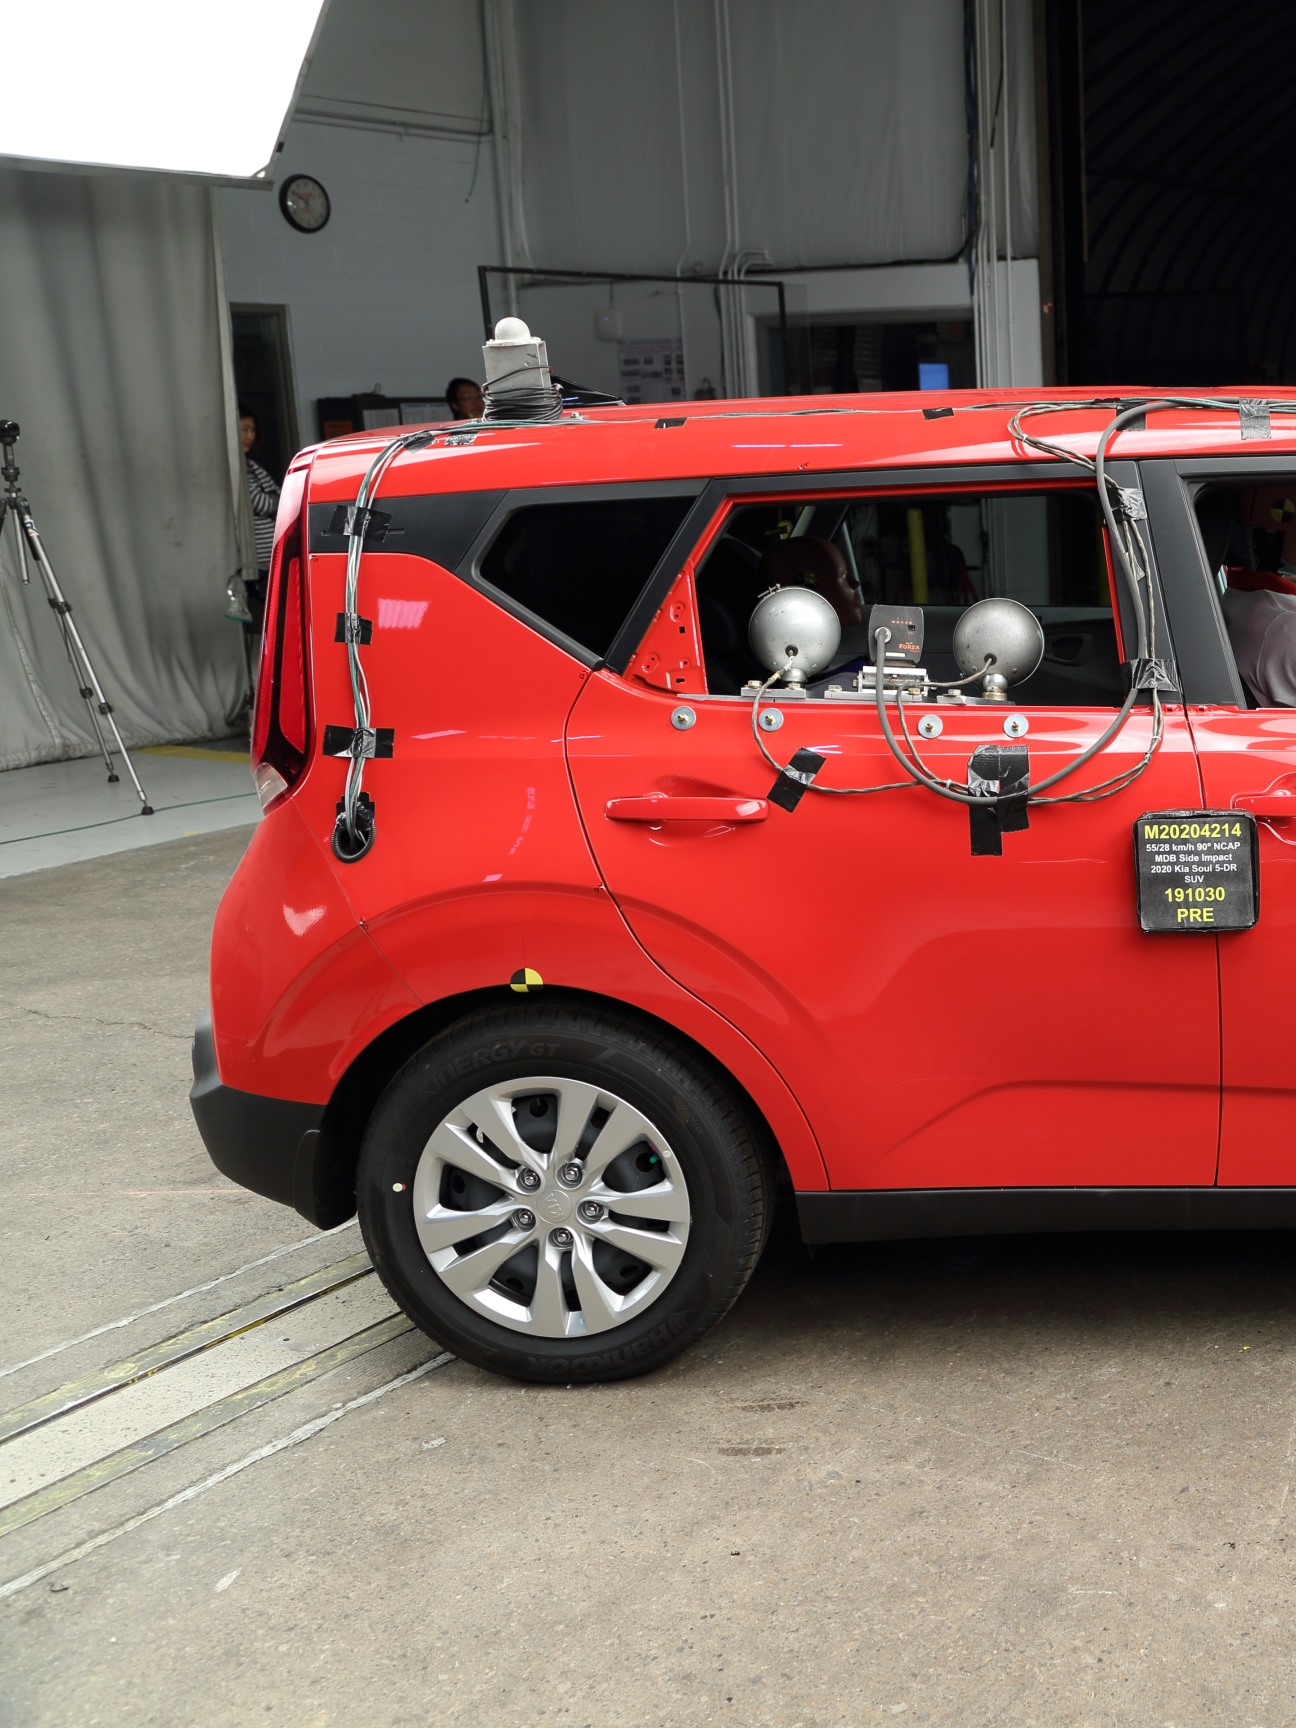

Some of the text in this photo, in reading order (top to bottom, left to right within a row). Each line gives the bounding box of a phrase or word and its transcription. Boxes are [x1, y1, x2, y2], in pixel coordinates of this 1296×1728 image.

[1144, 823, 1242, 839] M20204214
[1146, 843, 1170, 852] 55/28
[1172, 843, 1195, 851] km/h
[1213, 841, 1241, 851] NCAP
[1154, 853, 1233, 863] MDB Side Impact
[1150, 863, 1238, 873] 2020 Kia Soul 5-DR
[1184, 875, 1205, 883] SUV
[1164, 887, 1226, 903] 191030
[1177, 907, 1215, 923] PRE
